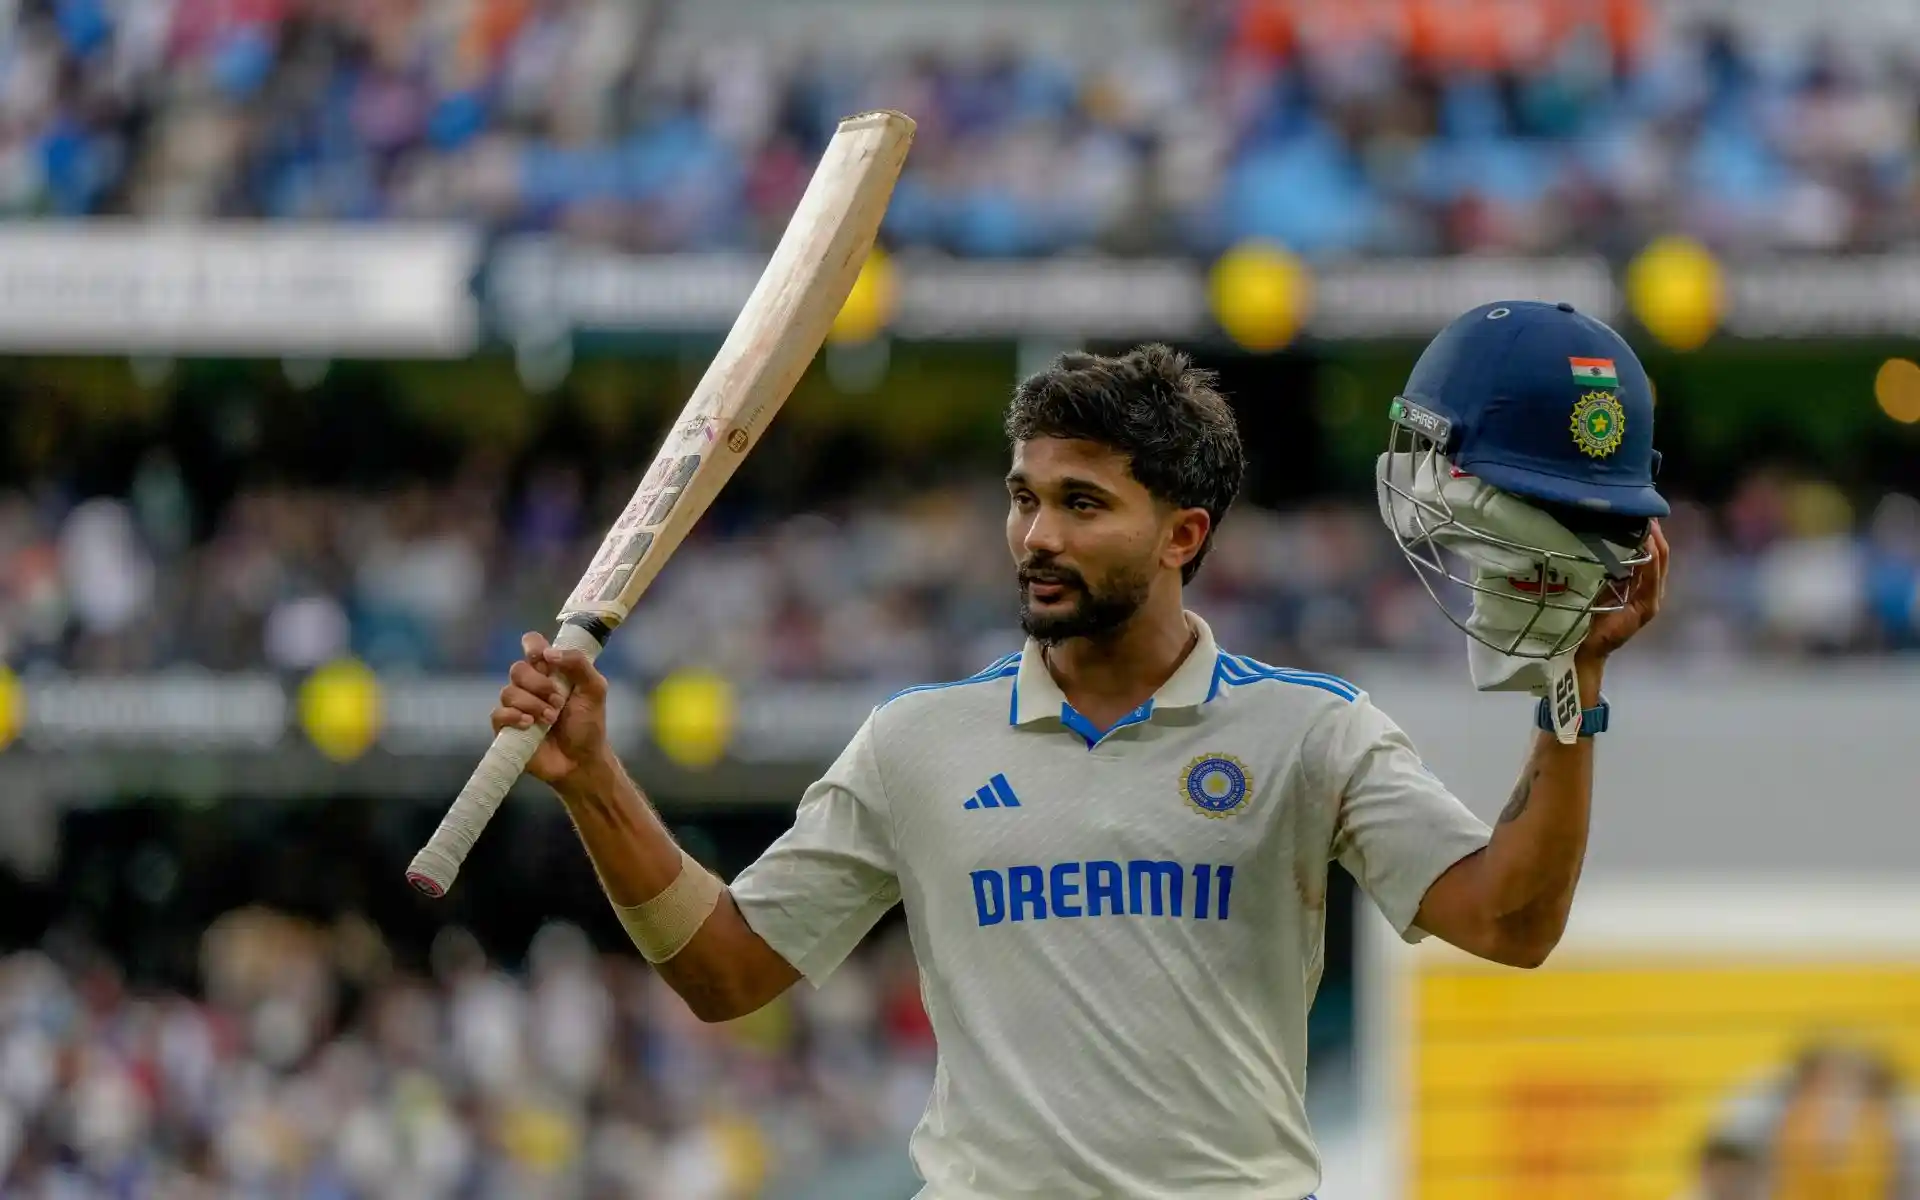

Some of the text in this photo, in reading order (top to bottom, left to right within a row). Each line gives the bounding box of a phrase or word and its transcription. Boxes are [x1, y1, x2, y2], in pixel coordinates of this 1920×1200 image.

[1410, 408, 1439, 431] SHREY
[1556, 668, 1577, 728] SS
[969, 860, 1234, 926] DREAM11
